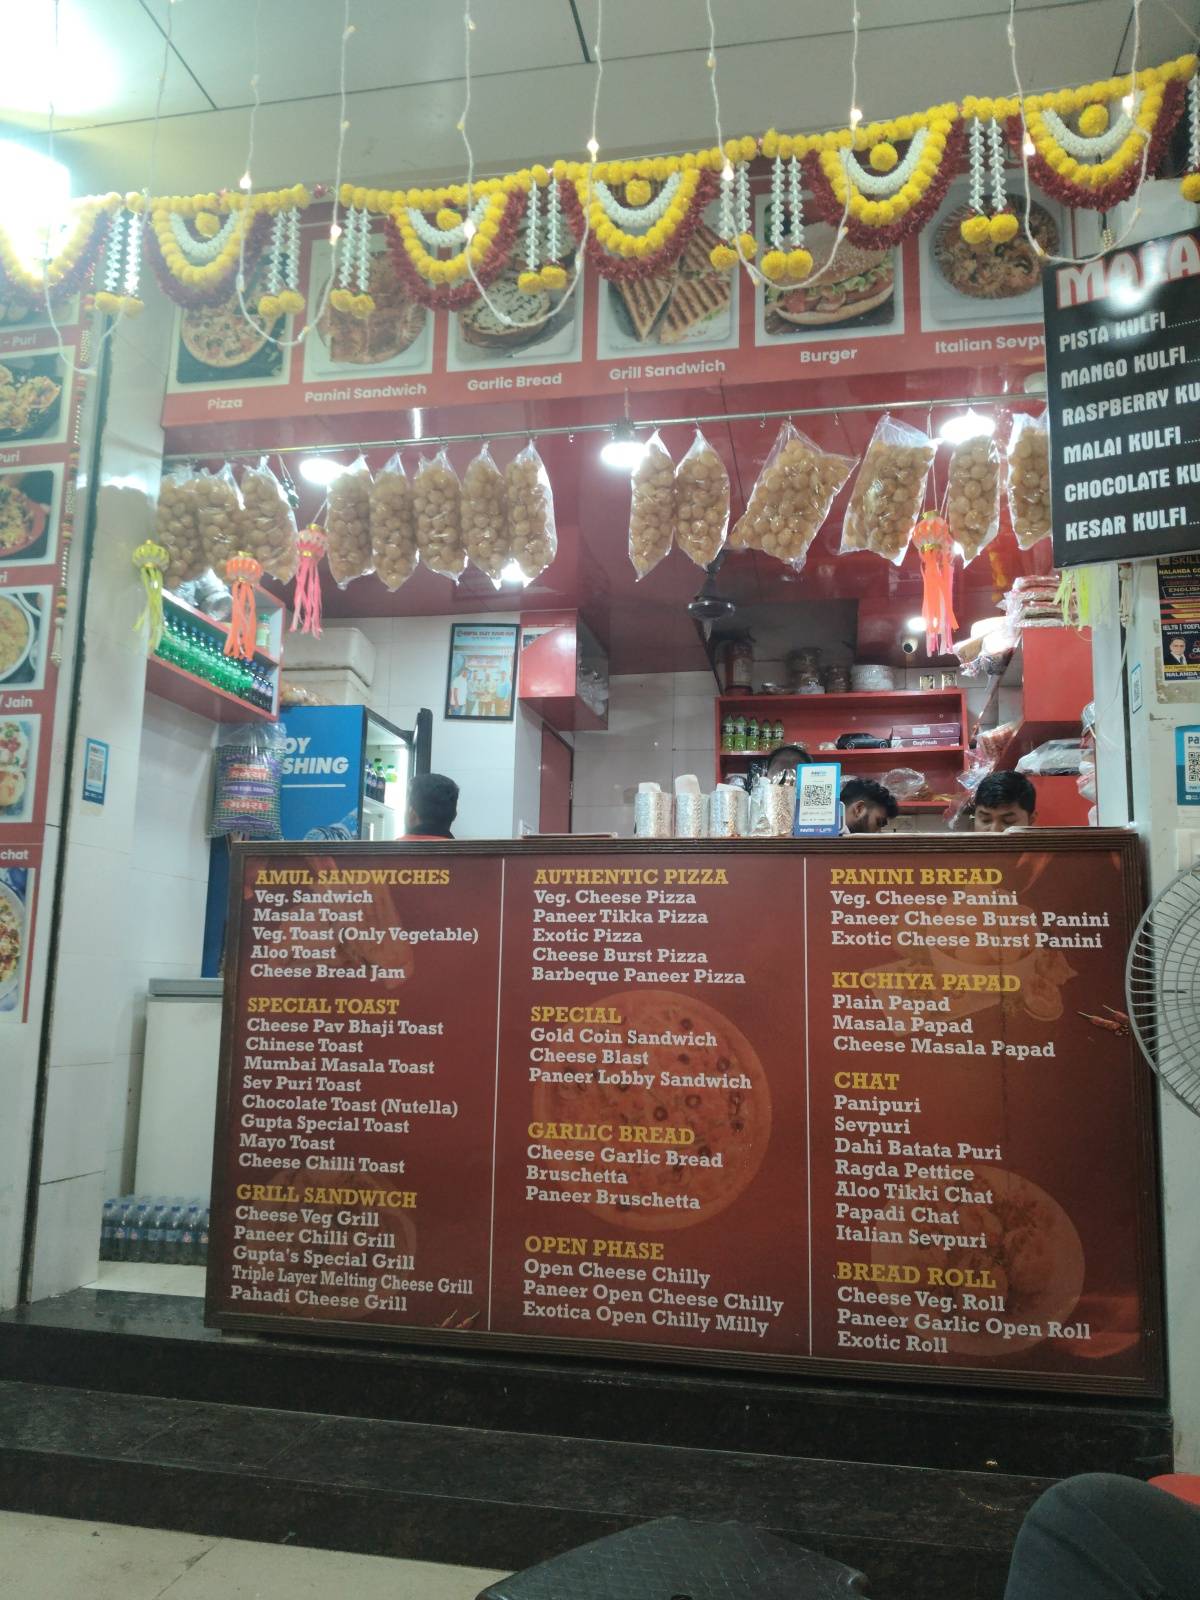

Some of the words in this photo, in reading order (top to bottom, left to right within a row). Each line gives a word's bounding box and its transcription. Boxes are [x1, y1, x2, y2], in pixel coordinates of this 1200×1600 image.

[1060, 326, 1109, 353] PISTA
[1115, 311, 1166, 340] KULFI
[800, 347, 858, 365] Burger
[935, 338, 992, 354] Italian
[609, 366, 642, 381] Grill
[645, 359, 726, 379] Sandwich
[1061, 358, 1128, 389] MANGO
[1133, 346, 1186, 373] KULFI
[467, 376, 512, 391] Garlic
[516, 372, 563, 388] Bread
[304, 388, 350, 403] Panini
[353, 383, 428, 399] Sandwich
[207, 397, 243, 410] Pizza
[1062, 388, 1169, 427] RASPBERRY
[1063, 437, 1122, 465] MALAI
[1128, 426, 1182, 453] KULFI
[1064, 468, 1170, 503] CHOCOLATE
[1065, 515, 1127, 542] KESAR
[1132, 506, 1187, 532] KULFI
[256, 870, 313, 884] AMUL
[319, 870, 449, 884] SANDWICHES
[534, 869, 658, 884] AUTHENTIC
[664, 869, 728, 884] PIZZA
[831, 869, 914, 884] PANINI
[920, 869, 1002, 884] BREAD
[255, 890, 288, 906] Veg.
[293, 890, 373, 903] Sandwich
[534, 890, 570, 907] Veg.
[576, 890, 641, 903] Cheese
[647, 890, 696, 904] Pizza
[830, 891, 870, 908] Veg.
[876, 891, 947, 905] Cheese
[953, 891, 1018, 905] Panini
[533, 909, 596, 922] Paneer
[600, 909, 653, 923] Tikka
[658, 910, 708, 923] Pizza
[252, 927, 286, 943] Veg.
[290, 927, 334, 940] Toast
[338, 927, 386, 944] (Only
[389, 928, 478, 944] Vegetable)
[832, 931, 891, 945] Exotic
[897, 931, 969, 946] Cheese
[976, 932, 1029, 947] Burst
[1035, 933, 1102, 948] Panini
[251, 964, 311, 977] Cheese
[316, 965, 366, 978] Bread
[370, 965, 405, 982] Jam
[532, 967, 619, 985] Barbeque
[624, 968, 689, 982] Paneer
[694, 969, 745, 983] Pizza
[832, 972, 936, 989] KICHIYA
[942, 974, 1020, 991] PAPAD
[248, 998, 331, 1013] SPECIAL
[335, 999, 399, 1014] TOAST
[833, 994, 883, 1009] Plain
[889, 996, 950, 1014] Papad
[531, 1006, 621, 1023] SPECIAL
[247, 1018, 308, 1032] Cheese
[313, 1019, 344, 1032] Pav
[349, 1020, 394, 1037] Bhaji
[398, 1021, 443, 1035] Toast
[531, 1028, 574, 1042] Gold
[580, 1029, 622, 1043] Coin
[628, 1030, 717, 1046] Sandwich
[834, 1036, 905, 1052] Cheese
[911, 1039, 986, 1055] Masala
[992, 1040, 1055, 1060] Papad
[244, 1056, 316, 1071] Mumbai
[321, 1058, 385, 1072] Masala
[388, 1059, 434, 1074] Toast
[529, 1068, 593, 1083] Paneer
[598, 1070, 655, 1089] Lobby
[661, 1072, 752, 1089] Sandwich
[835, 1072, 899, 1090] CHAT
[242, 1094, 327, 1110] Chocolate
[331, 1097, 376, 1112] Toast
[381, 1099, 457, 1118] (Nutella)
[834, 1095, 921, 1115] Panipuri
[241, 1114, 292, 1132] Gupta
[297, 1116, 359, 1133] Special
[363, 1118, 409, 1133] Toast
[528, 1122, 612, 1141] GARLIC
[619, 1126, 695, 1144] BREAD
[527, 1144, 595, 1161] Cheese
[601, 1148, 660, 1164] Garlic
[666, 1151, 723, 1167] Bread
[835, 1138, 882, 1154] Dahi
[888, 1140, 952, 1157] Batata
[958, 1143, 1002, 1160] Puri
[239, 1153, 300, 1169] Cheese
[306, 1156, 355, 1171] Chilli
[359, 1158, 405, 1173] Toast
[526, 1165, 628, 1184] Bruschetta
[237, 1184, 299, 1202] GRILL
[304, 1187, 417, 1208] SANDWICH
[835, 1181, 879, 1197] Aloo
[884, 1184, 939, 1201] Tikki
[945, 1187, 992, 1204] Chat
[236, 1206, 297, 1222] Cheese
[301, 1209, 332, 1228] Veg
[338, 1211, 379, 1227] Grill
[233, 1246, 299, 1264] Gupta's
[304, 1250, 367, 1268] Special
[373, 1254, 414, 1270] Grill
[525, 1236, 587, 1255] OPEN
[593, 1240, 664, 1260] PHASE
[232, 1265, 274, 1284] Triple
[278, 1268, 317, 1287] Layer
[320, 1271, 377, 1292] Melting
[381, 1275, 433, 1292] Cheese
[438, 1278, 472, 1294] Grill
[837, 1262, 920, 1283] BREAD
[928, 1268, 996, 1288] ROLL
[231, 1285, 290, 1303] Pahadi
[295, 1290, 359, 1307] Cheese
[365, 1295, 407, 1311] Grill
[524, 1280, 588, 1298] Paneer
[593, 1284, 643, 1304] Open
[649, 1288, 718, 1307] Cheese
[724, 1293, 784, 1316] Chilly
[838, 1286, 911, 1305] Cheese
[915, 1291, 957, 1312] Veg.
[963, 1294, 1005, 1311] Roll
[523, 1301, 591, 1319] Exotica
[596, 1306, 647, 1326] Open
[652, 1310, 710, 1332] Chilly
[716, 1315, 769, 1337] Milly
[838, 1308, 908, 1328] Paneer
[915, 1314, 979, 1332] Garlic
[986, 1318, 1042, 1339] Open
[1048, 1322, 1091, 1339] Roll
